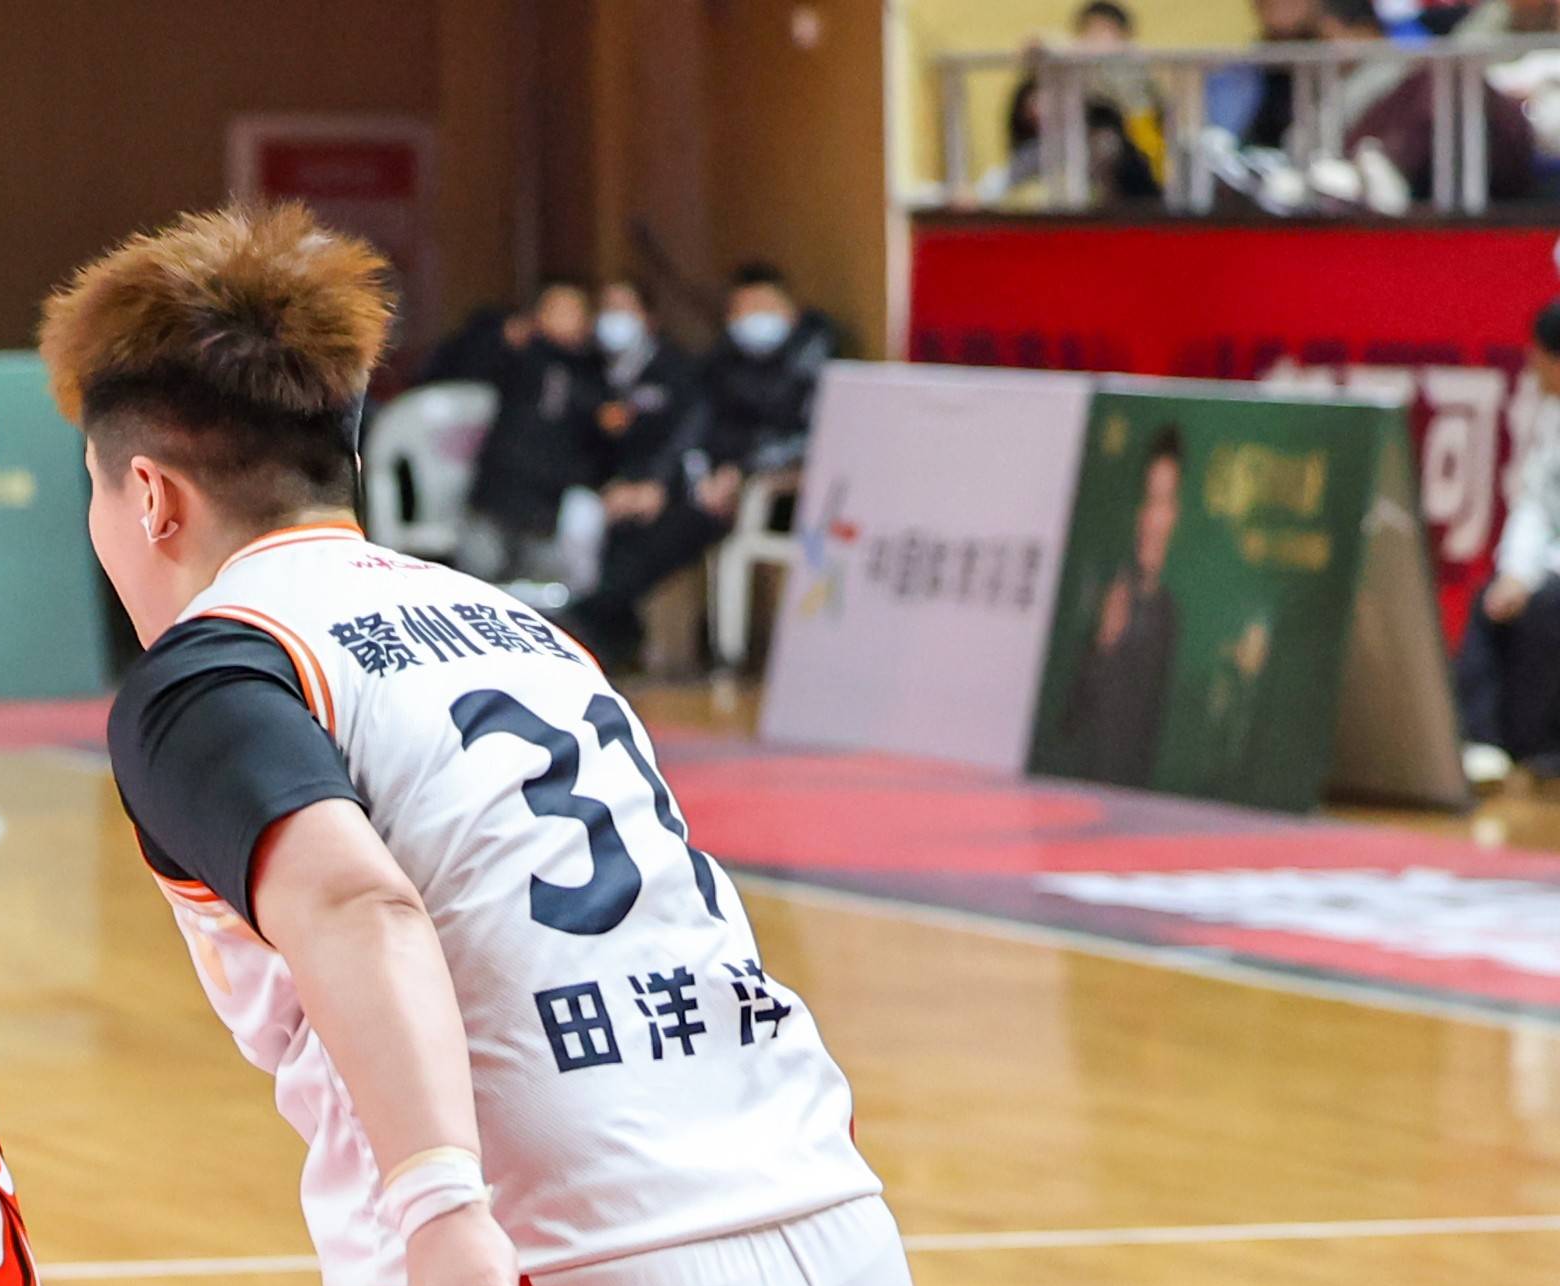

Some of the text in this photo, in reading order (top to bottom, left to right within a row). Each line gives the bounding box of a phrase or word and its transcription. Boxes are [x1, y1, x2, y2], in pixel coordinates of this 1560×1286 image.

[450, 689, 727, 936] 31
[533, 958, 792, 1073] 田洋洋
